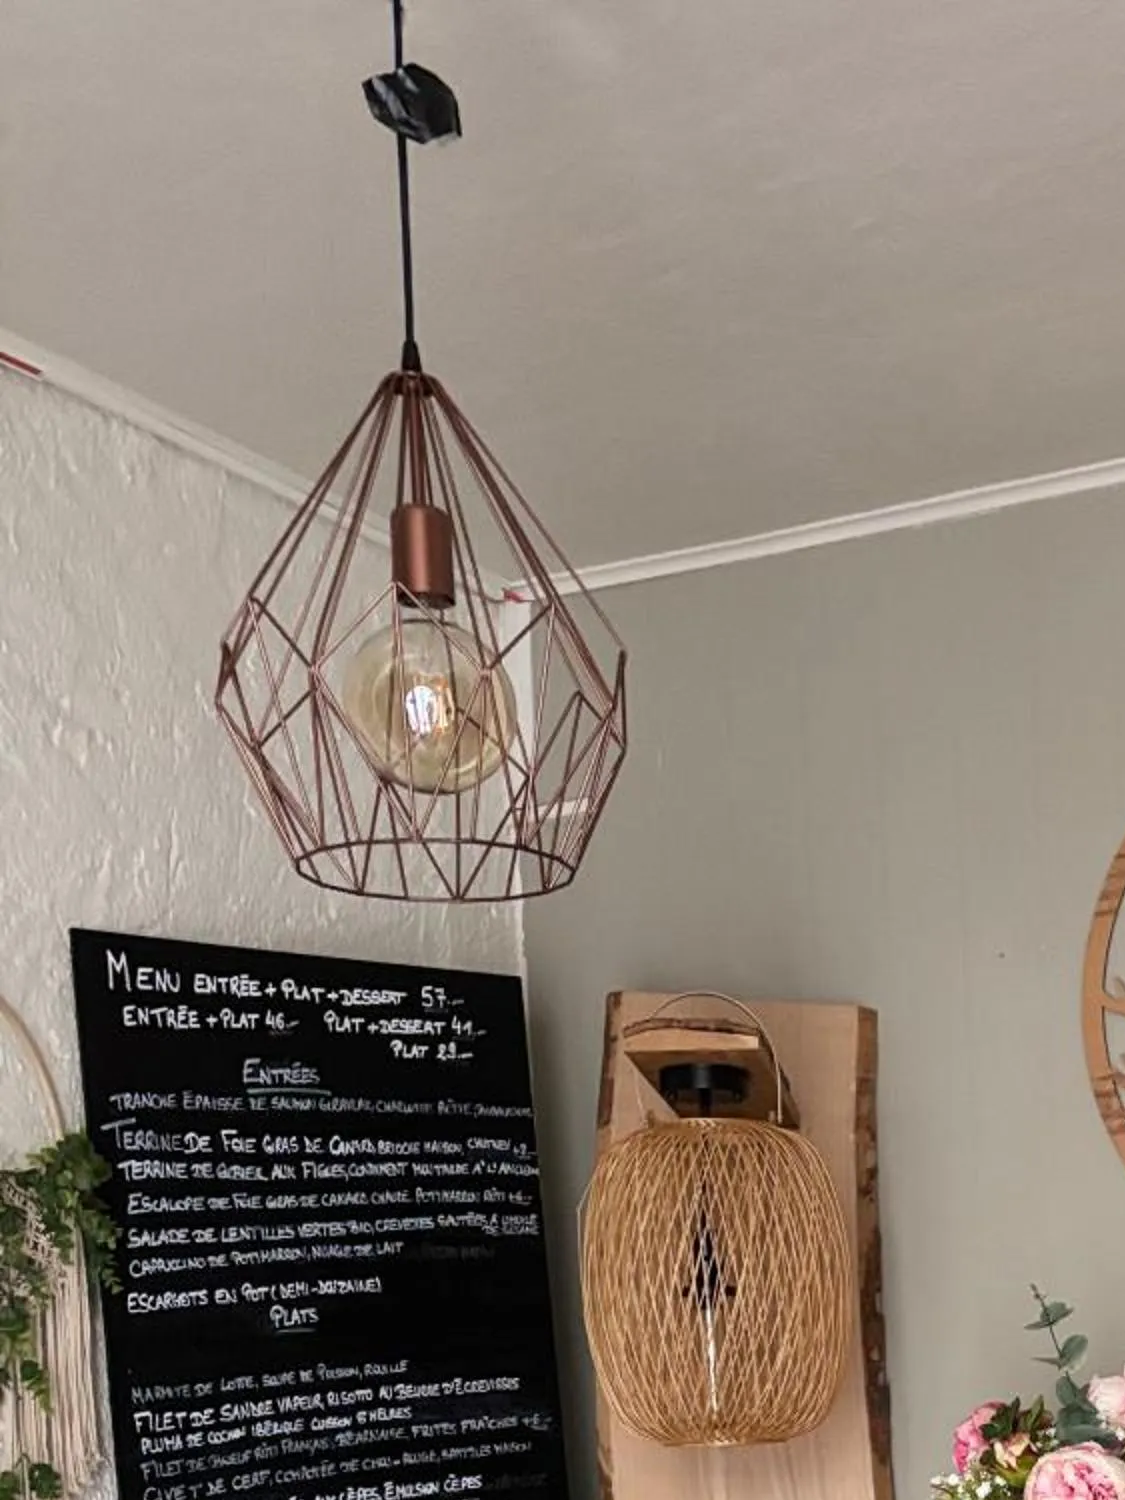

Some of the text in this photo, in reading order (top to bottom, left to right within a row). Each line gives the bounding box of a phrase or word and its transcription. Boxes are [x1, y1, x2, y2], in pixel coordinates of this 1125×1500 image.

[106, 949, 180, 992] MENU
[390, 1039, 429, 1058] PLAT
[243, 1058, 320, 1084] ENTRÉES
[109, 1092, 177, 1111] TRANCHE
[251, 1098, 268, 1111] DE
[100, 1117, 182, 1149] TERRINE
[183, 1131, 213, 1154] DE
[220, 1129, 257, 1153] FOIE
[261, 1134, 299, 1154] GRAS
[304, 1136, 322, 1153] DE
[117, 1158, 188, 1181] TERRINE
[191, 1162, 214, 1179] DE
[271, 1162, 296, 1180] AUX
[127, 1192, 205, 1215] ESCALOPE
[208, 1197, 232, 1210] DE
[231, 1192, 264, 1210] FOIE
[265, 1194, 298, 1209] GRAS
[299, 1195, 320, 1208] DE
[127, 1228, 191, 1249] SALADE
[191, 1228, 218, 1243] DE
[221, 1224, 295, 1243] LENTILLES
[297, 1220, 347, 1238] VERTES
[207, 1253, 229, 1267] DE
[376, 1241, 404, 1255] LAIT
[127, 1282, 269, 1314] ESCARGOTS EN POT
[269, 1304, 319, 1328] PLATS
[193, 1382, 213, 1397] DE
[133, 1411, 188, 1433] FILET
[189, 1408, 216, 1428] DE
[219, 1400, 276, 1422] SANDRE
[327, 1388, 373, 1407] RISOTTO
[379, 1386, 393, 1400] AU
[393, 1383, 441, 1400] BEURRE
[141, 1434, 184, 1455] PLUMA
[185, 1431, 205, 1449] DE
[311, 1415, 353, 1431] CUISSON
[369, 1406, 413, 1423] HEURES
[140, 1458, 185, 1481] FILET
[185, 1457, 207, 1473] DE
[206, 1478, 227, 1496] DE
[443, 1474, 483, 1492] CÈPES
